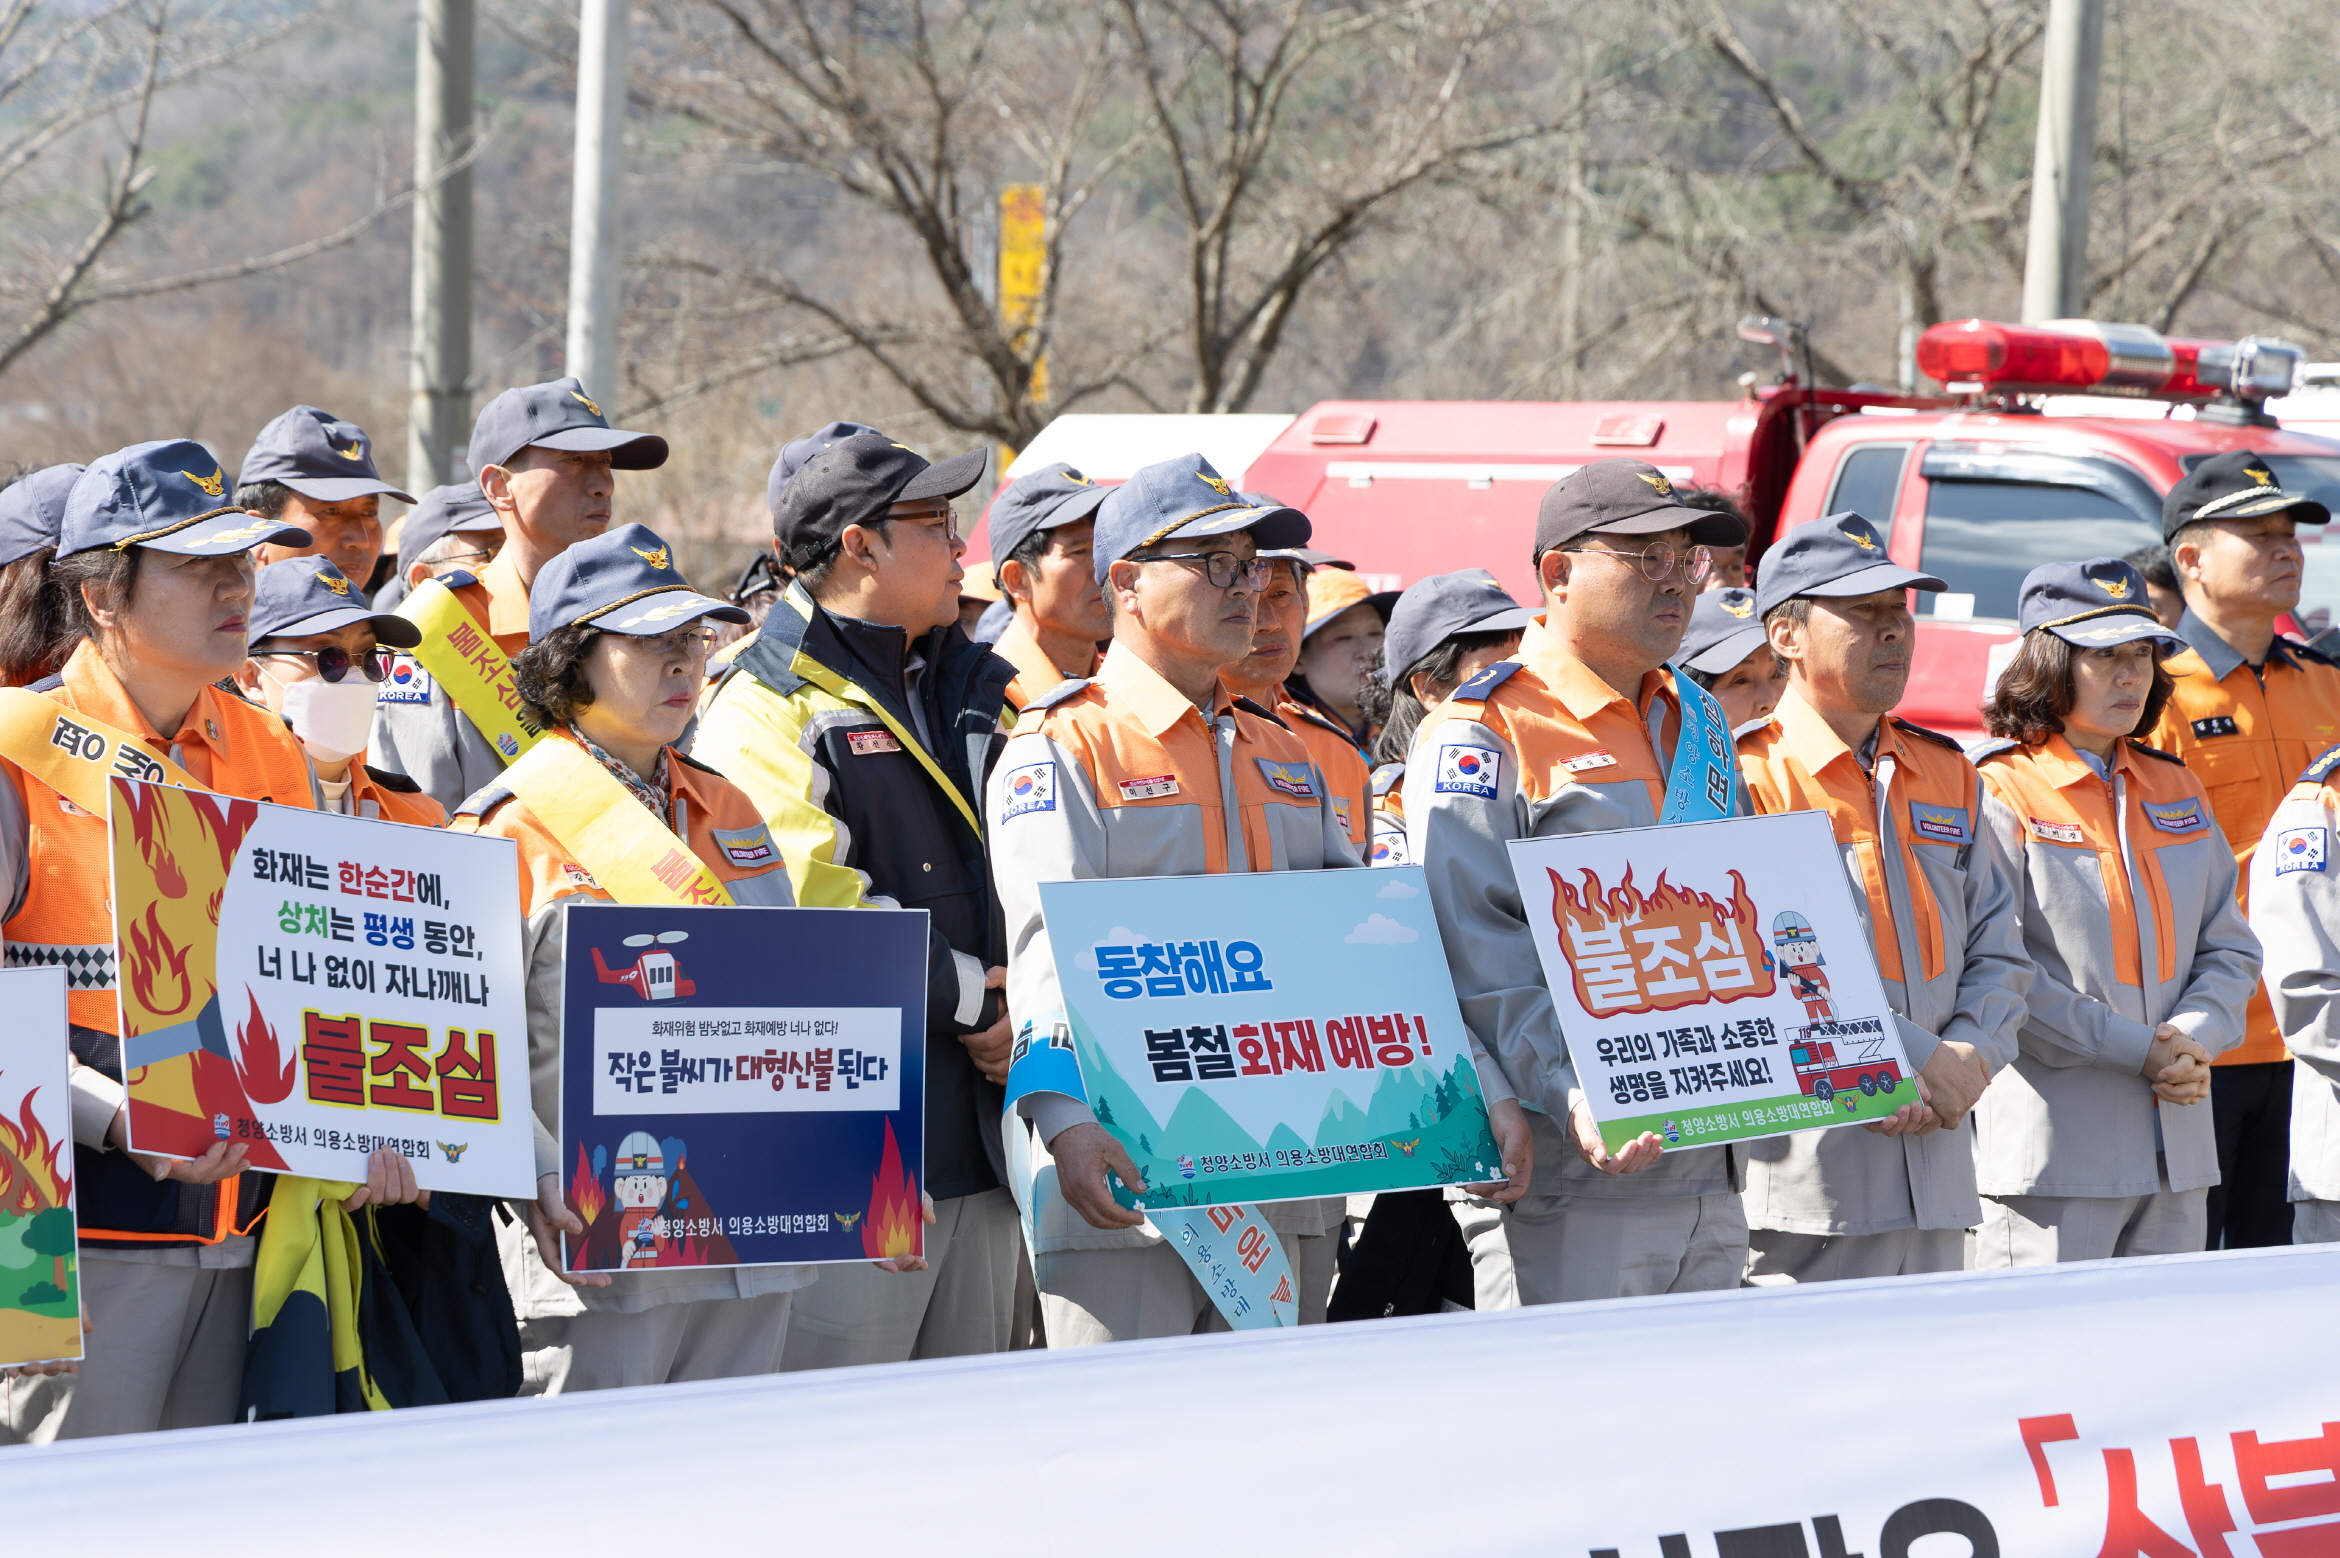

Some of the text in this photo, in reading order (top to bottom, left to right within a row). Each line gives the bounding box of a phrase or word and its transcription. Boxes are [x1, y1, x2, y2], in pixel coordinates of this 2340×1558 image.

[379, 691, 422, 701] KOREA
[1004, 800, 1046, 818] KOREA
[1443, 782, 1490, 796] KOREA
[1922, 823, 1950, 833] VOLUNTEER
[251, 848, 451, 910] 화재는 한순간에,
[650, 848, 732, 906] 불조
[2279, 862, 2319, 873] KOREA
[277, 901, 484, 961] 상처는 평생 동안,
[258, 946, 489, 1007] 너 나 없이 자나깨나
[1096, 940, 1273, 1000] 동참해요
[1567, 910, 1756, 1011] 불조심
[652, 1020, 695, 1036] 화재위험
[698, 1020, 742, 1036] 밤낮없고
[744, 1020, 787, 1036] 화재예방
[814, 1020, 838, 1036] 없다!
[1144, 1012, 1433, 1083] 봄철 화재 예방!
[1597, 1016, 1778, 1068] 우리의 가족과 소중한
[1798, 1027, 1812, 1039] 119
[303, 1010, 501, 1122] 불조심
[607, 1048, 888, 1094] 작은 불씨가 대형산불 된다
[1609, 1057, 1773, 1105] 생명을 지켜주세요!
[237, 1117, 307, 1147] 청양소방서
[1682, 1098, 1835, 1137] 청양소방서 의용소방대연합회
[1200, 1141, 1388, 1174] 청양소방서 의용소방대연합회
[660, 1213, 829, 1239] 청양소방서 의용소방대연합회
[1181, 1222, 1252, 1318] 의용소방대
